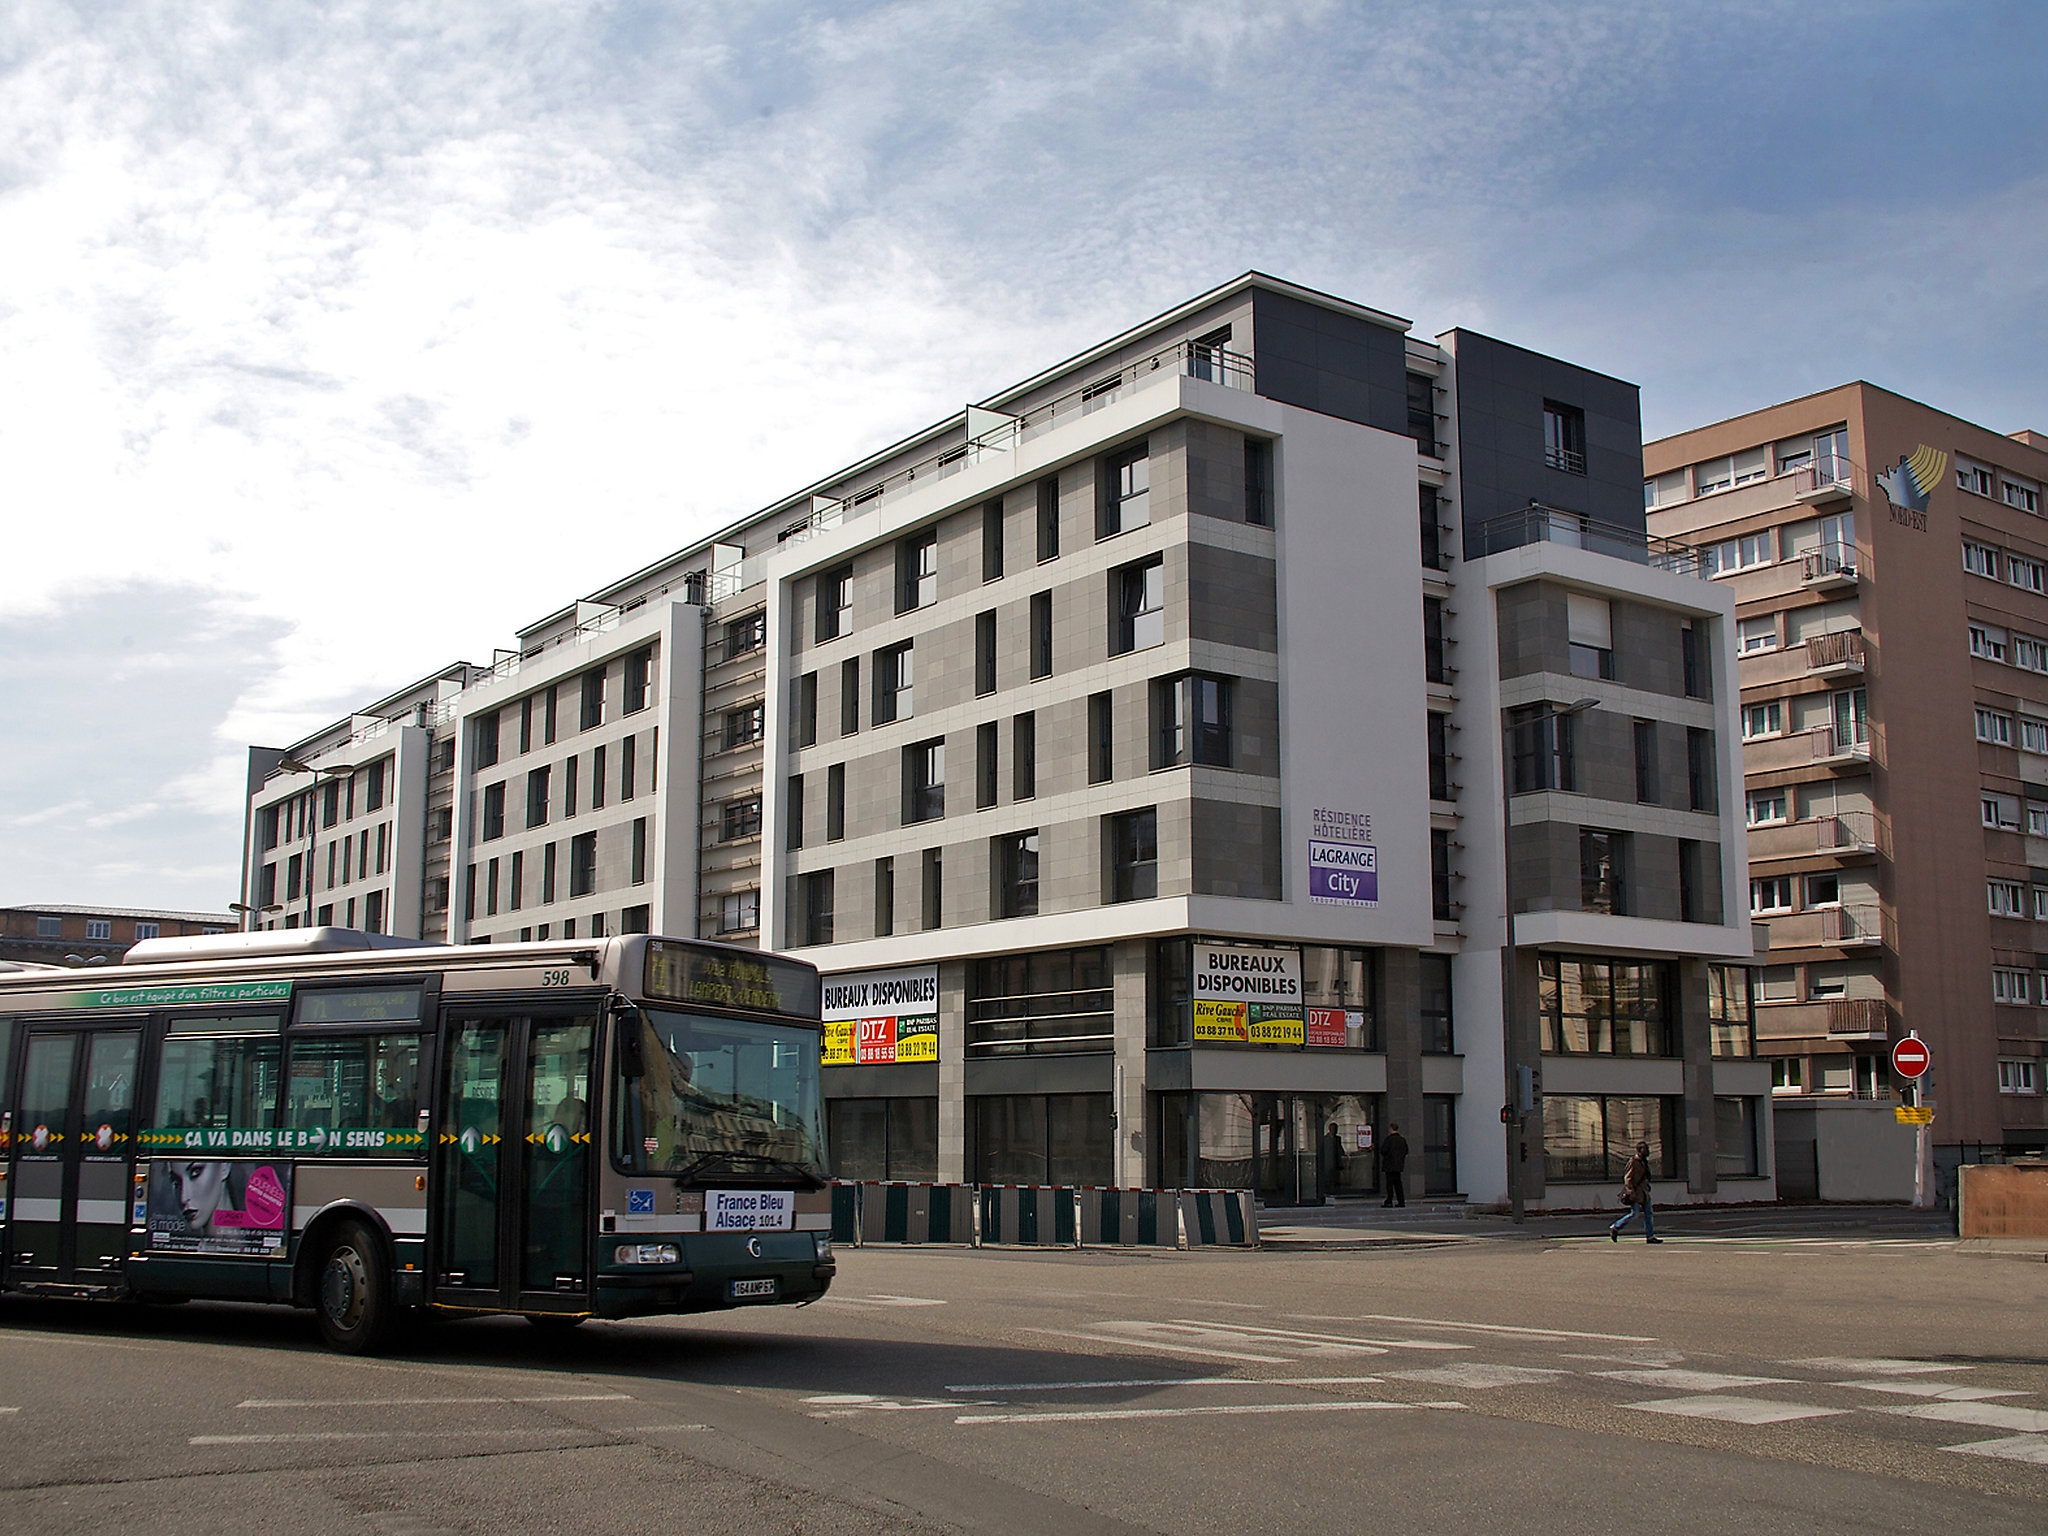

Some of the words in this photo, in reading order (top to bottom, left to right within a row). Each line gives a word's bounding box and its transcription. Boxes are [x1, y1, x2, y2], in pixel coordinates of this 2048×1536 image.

[1313, 808, 1372, 828] RÉSIDENCE
[1313, 823, 1373, 842] HÔTELIÈRE
[1312, 847, 1374, 867] LAGRANGE
[1328, 872, 1360, 897] City
[1209, 953, 1286, 973] BUREAUX
[542, 970, 570, 986] 598
[1198, 974, 1298, 995] DISPONIBLES
[101, 993, 112, 1004] Ce
[113, 992, 128, 1004] bus
[130, 993, 145, 1003] est
[200, 987, 226, 999] filtre
[238, 985, 287, 1000] particules
[825, 984, 869, 1010] BUREAUX
[873, 977, 935, 1006] DISPONIBLES
[1195, 1003, 1215, 1016] Rive
[1215, 1004, 1245, 1017] Gauche
[1310, 1011, 1331, 1025] DTZ
[861, 1020, 887, 1040] DTZ
[1196, 1025, 1206, 1035] 03
[1207, 1026, 1217, 1036] 88
[1217, 1026, 1227, 1036] 37
[1227, 1027, 1235, 1036] 11
[1251, 1026, 1260, 1038] 03
[1261, 1026, 1272, 1038] 88
[1272, 1026, 1282, 1038] 22
[1283, 1027, 1291, 1038] 19
[1292, 1027, 1302, 1038] 44
[928, 1041, 936, 1055] 44
[185, 1131, 202, 1149] ÇA
[208, 1130, 227, 1146] VA
[232, 1131, 272, 1147] DANS
[277, 1131, 292, 1146] LE
[346, 1131, 385, 1147] SENS
[716, 1193, 757, 1210] France
[759, 1193, 784, 1210] Bleu
[715, 1212, 756, 1228] Alsace
[759, 1215, 783, 1227] 101.4
